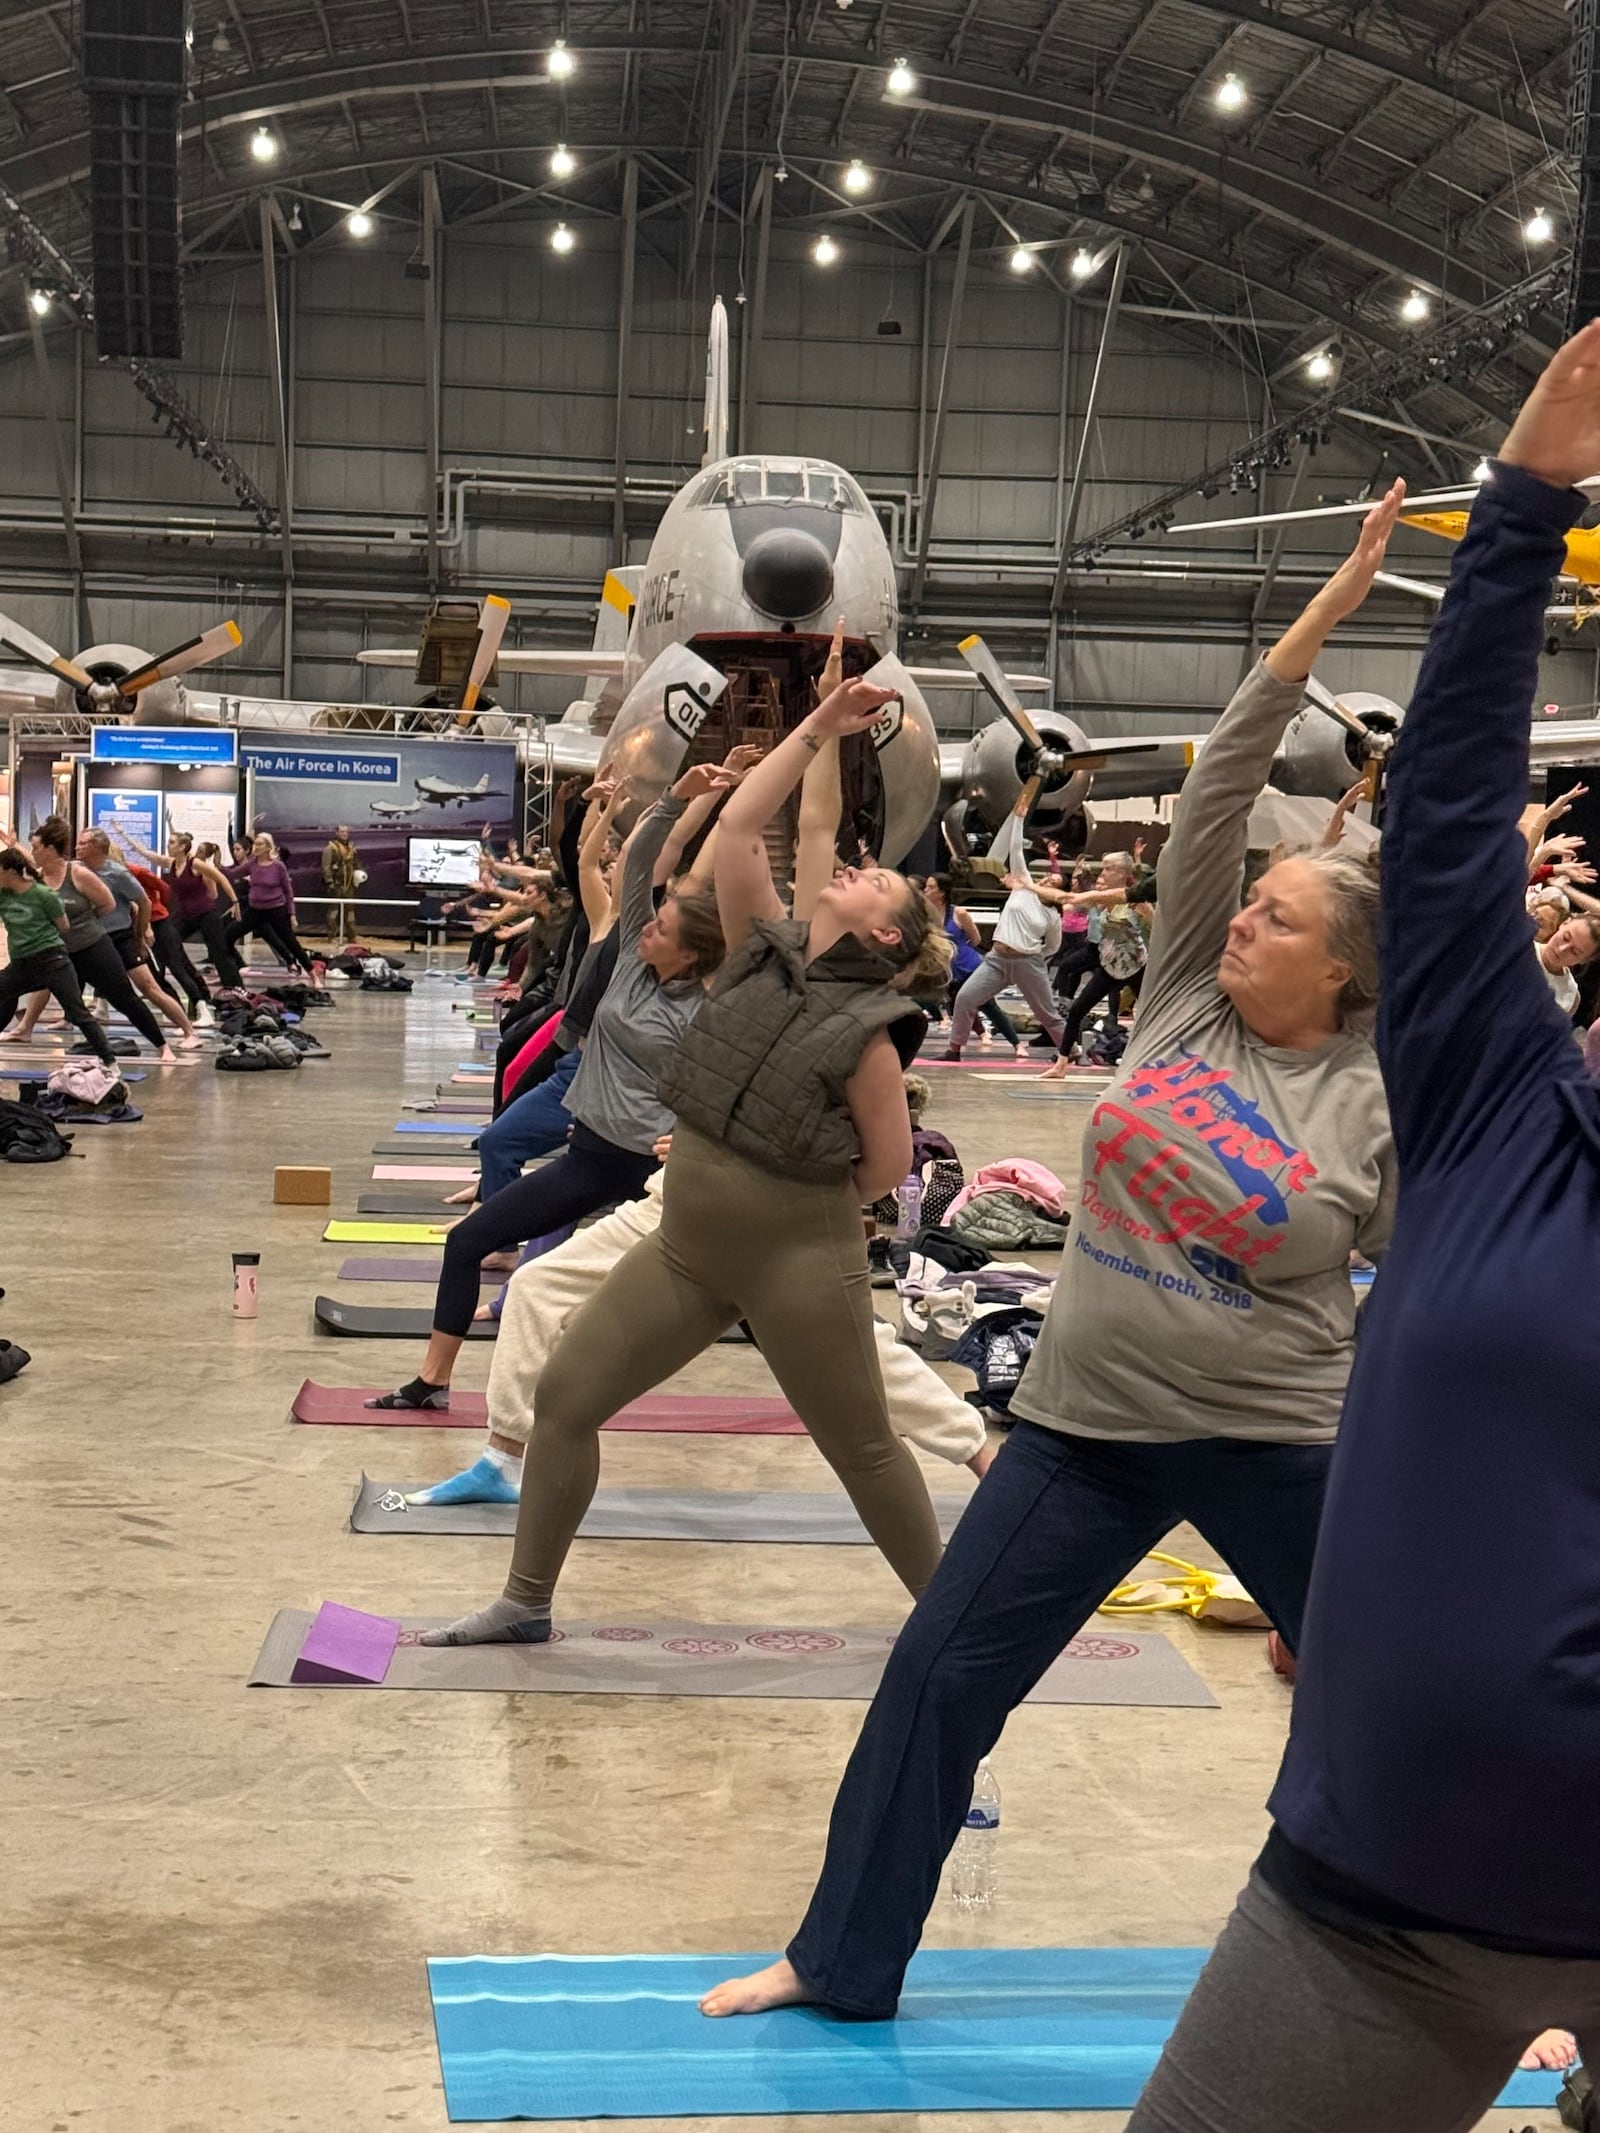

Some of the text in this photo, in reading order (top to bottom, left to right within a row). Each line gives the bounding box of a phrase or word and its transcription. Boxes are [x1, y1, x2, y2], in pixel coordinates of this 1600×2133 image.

[247, 756, 272, 769] The
[275, 757, 294, 770] Air
[298, 759, 334, 772] Force
[353, 761, 391, 775] Korea
[1121, 1055, 1318, 1193] Honor
[1081, 1180, 1152, 1241] Dayton
[1092, 1102, 1286, 1268] Flight
[1075, 1231, 1252, 1309] November 10th, 2018
